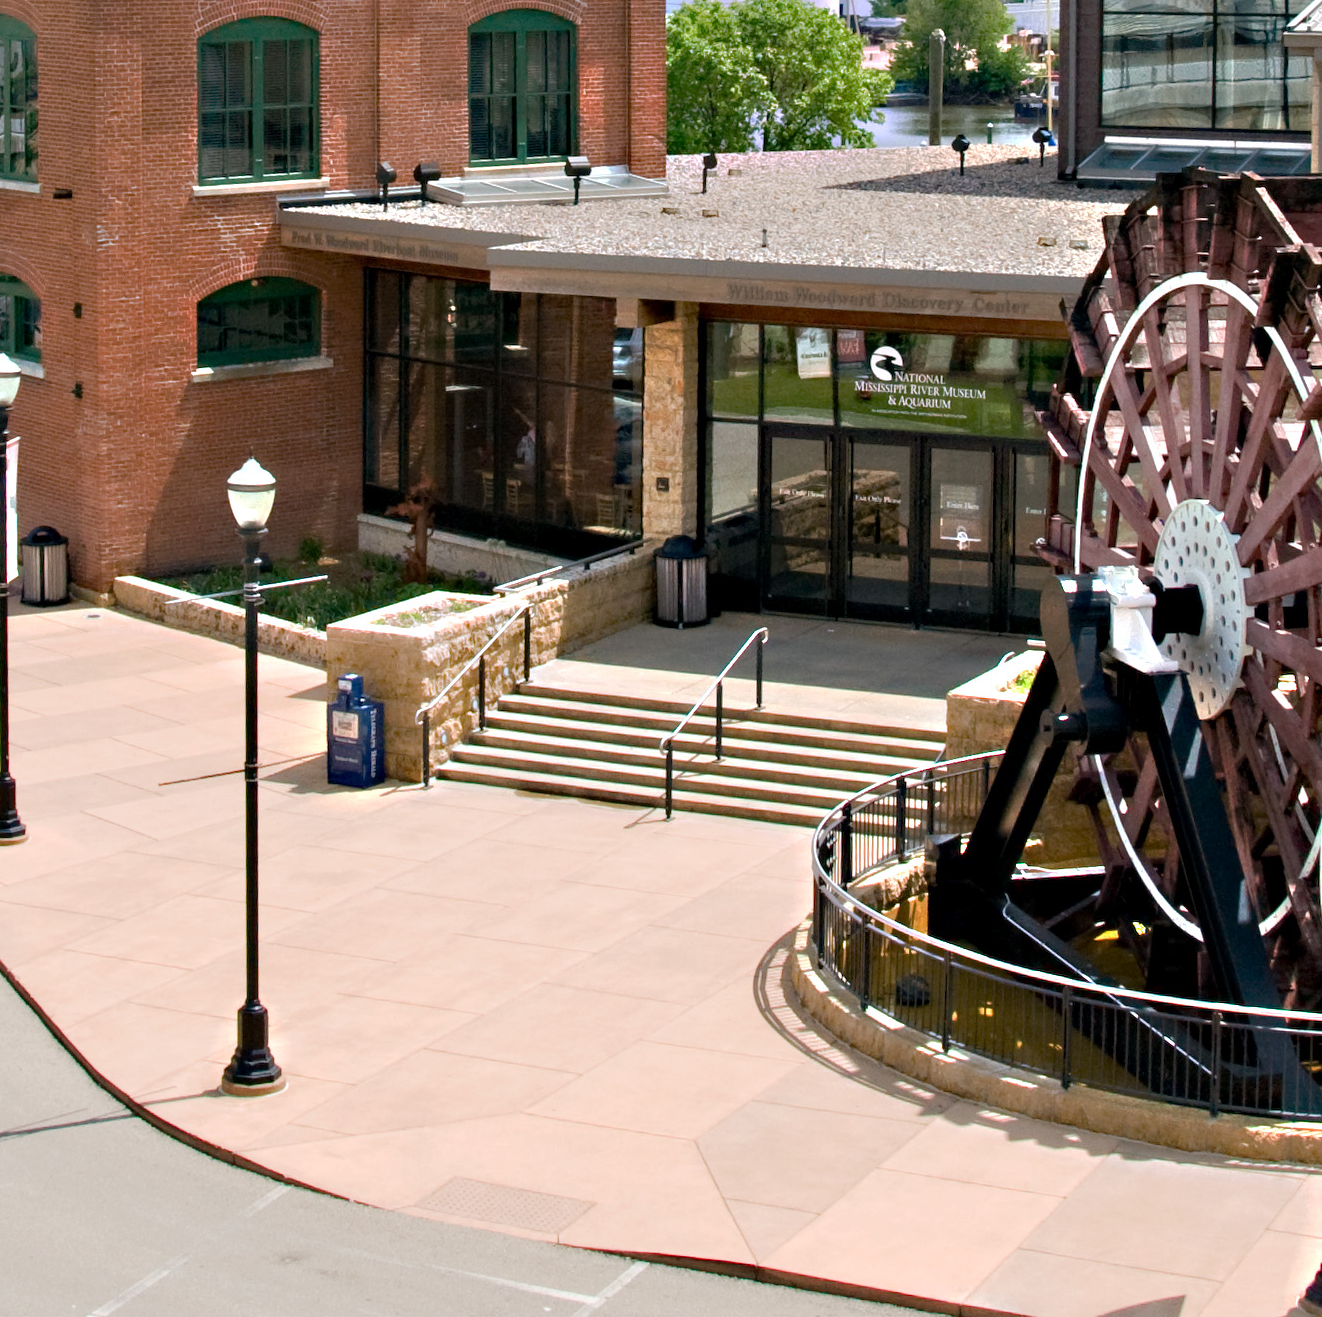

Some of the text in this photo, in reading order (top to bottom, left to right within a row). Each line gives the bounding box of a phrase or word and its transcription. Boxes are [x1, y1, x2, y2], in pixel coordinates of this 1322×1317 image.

[728, 283, 1029, 315] William Woodward Discovery Center
[894, 371, 946, 385] NATIONAL
[854, 380, 986, 400] MISSISSIPPI RIVER MUSEUM
[887, 394, 951, 409] & AQUARIUM
